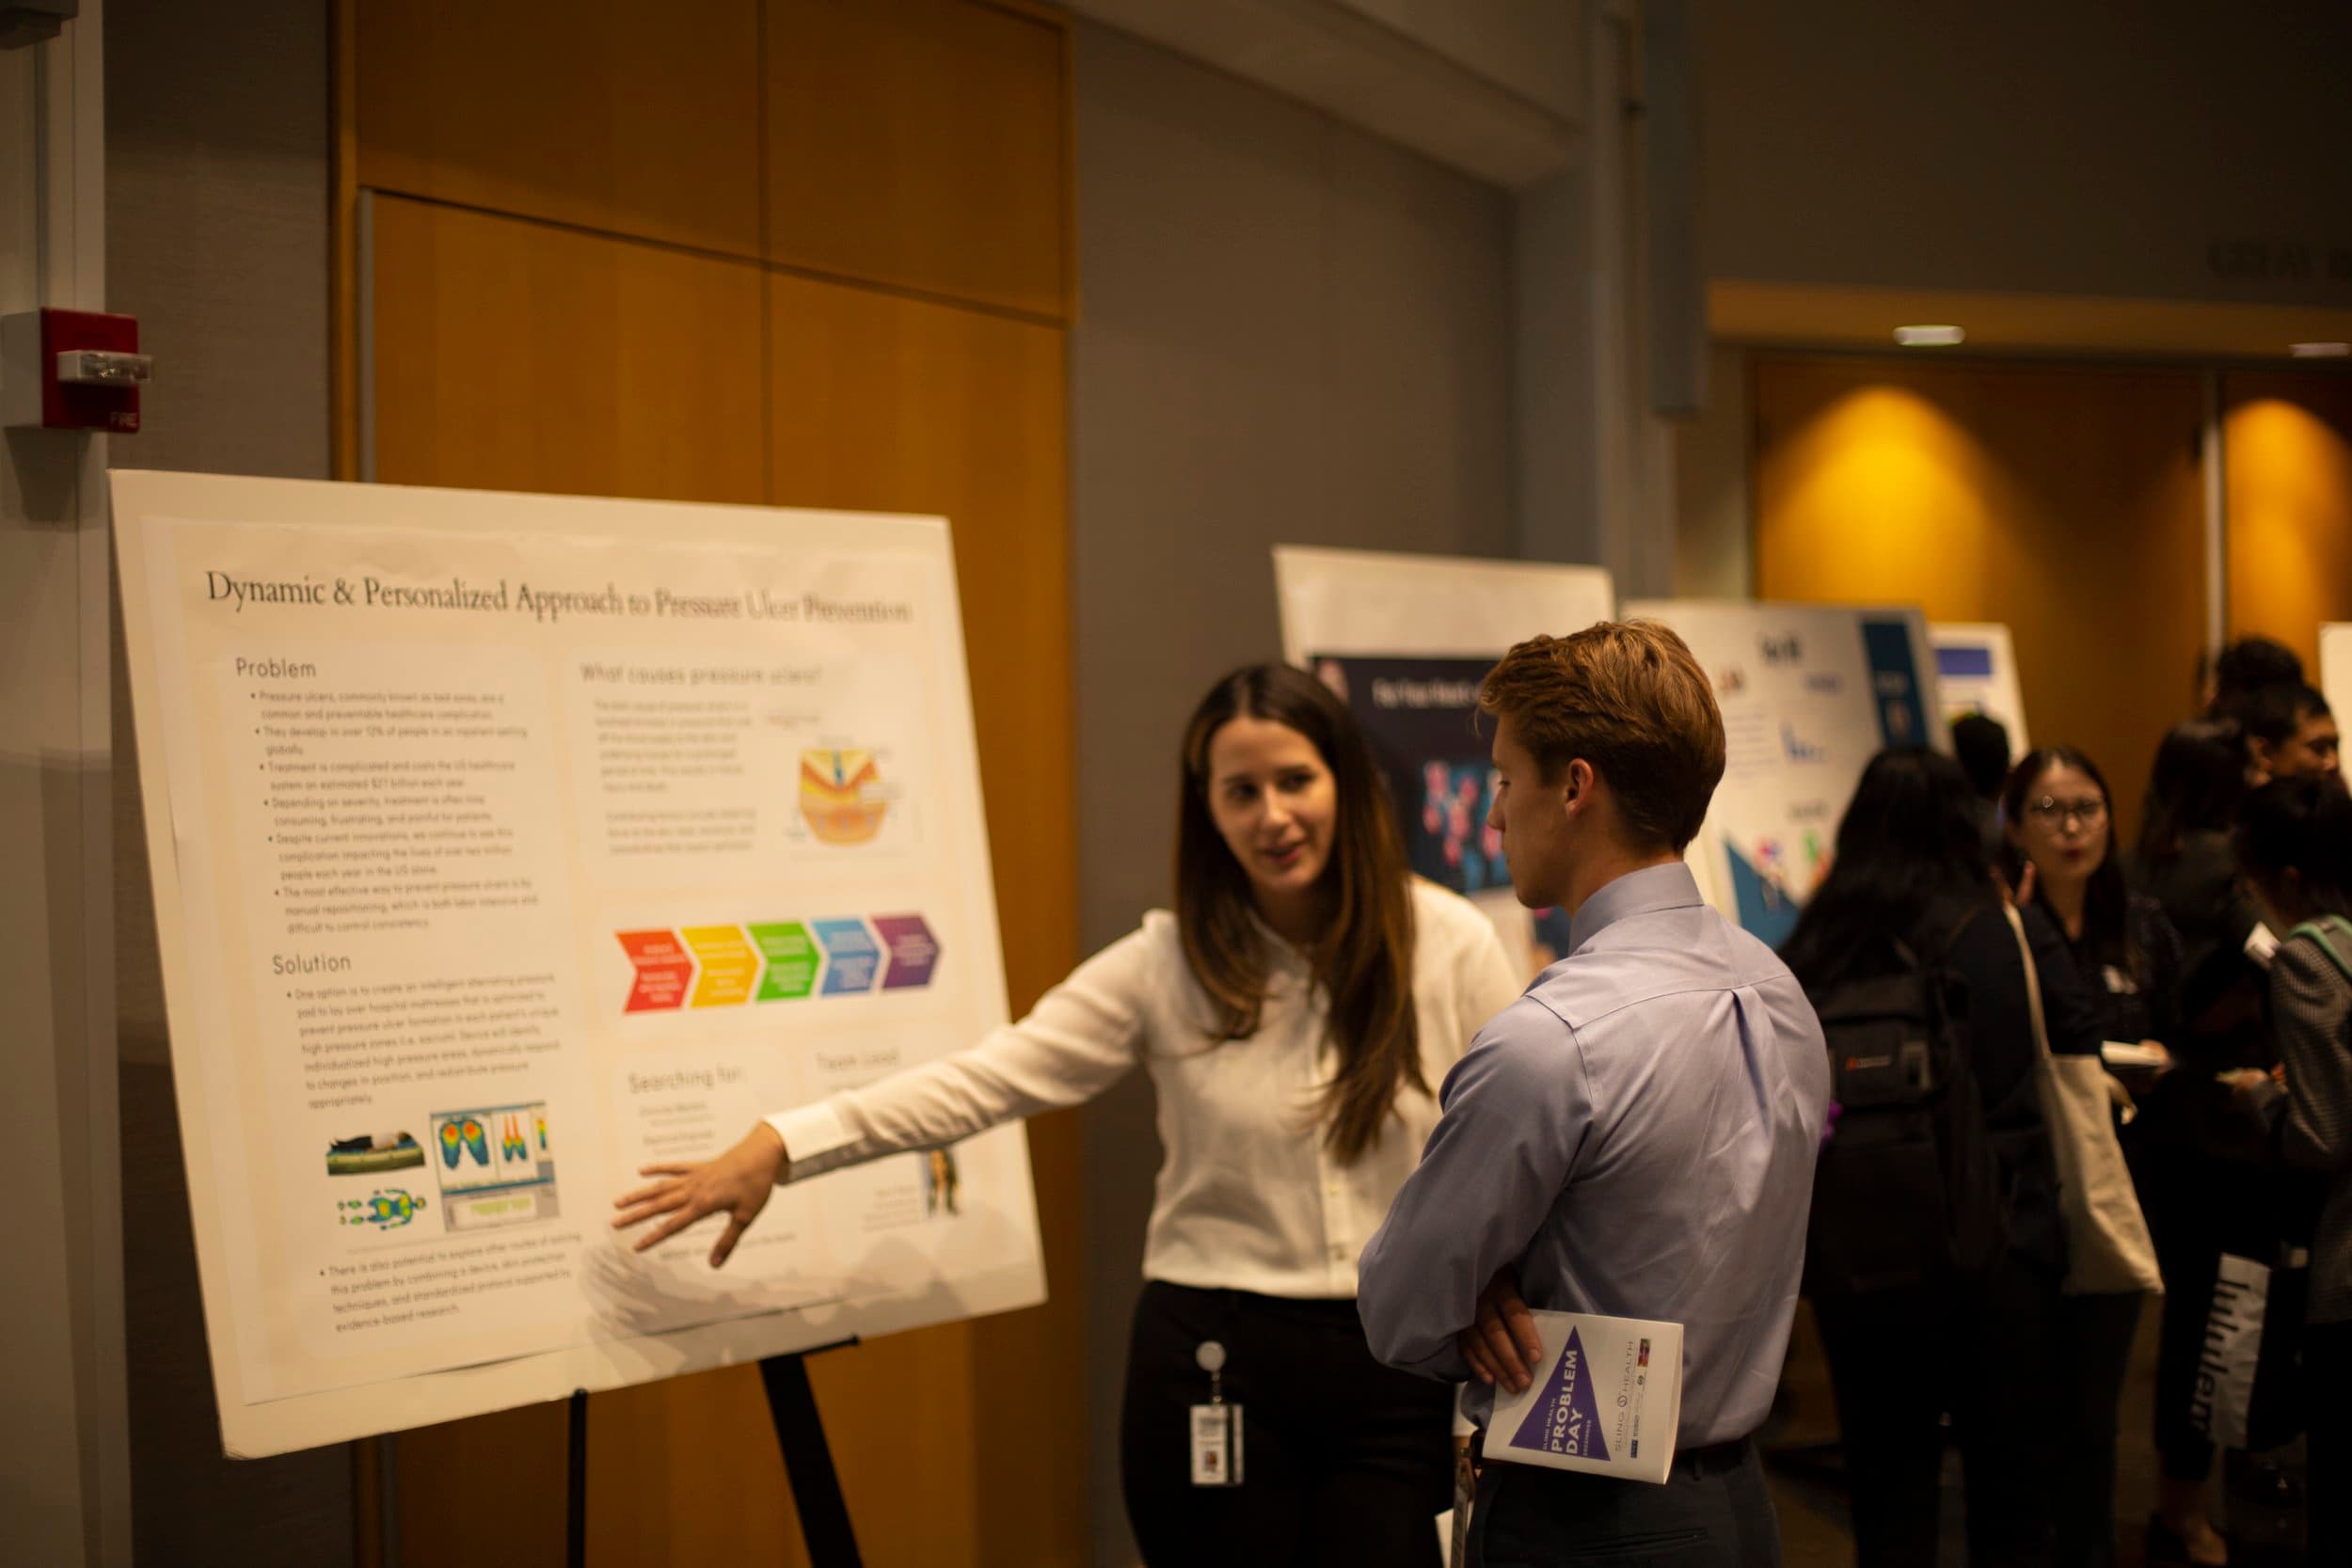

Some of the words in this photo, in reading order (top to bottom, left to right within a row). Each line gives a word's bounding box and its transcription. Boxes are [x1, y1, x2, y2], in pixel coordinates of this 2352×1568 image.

[206, 571, 326, 612] Dynamic
[333, 577, 356, 606] &
[364, 576, 508, 611] Personalized
[516, 581, 623, 622] Approach
[628, 592, 651, 615] to
[656, 588, 740, 619] Pressure
[746, 590, 799, 621] Ulcer
[803, 594, 914, 624] Prevention
[235, 657, 317, 678] Problem
[580, 661, 623, 683] What
[628, 666, 685, 685] causes
[690, 666, 762, 687] pressure
[272, 953, 352, 975] Solution
[628, 1066, 714, 1095] Searching
[1550, 1349, 1579, 1452] PROBLEM
[1614, 1412, 1625, 1452] SLING
[1623, 1340, 1634, 1392] HEALTH
[1565, 1408, 1583, 1454] DAY
